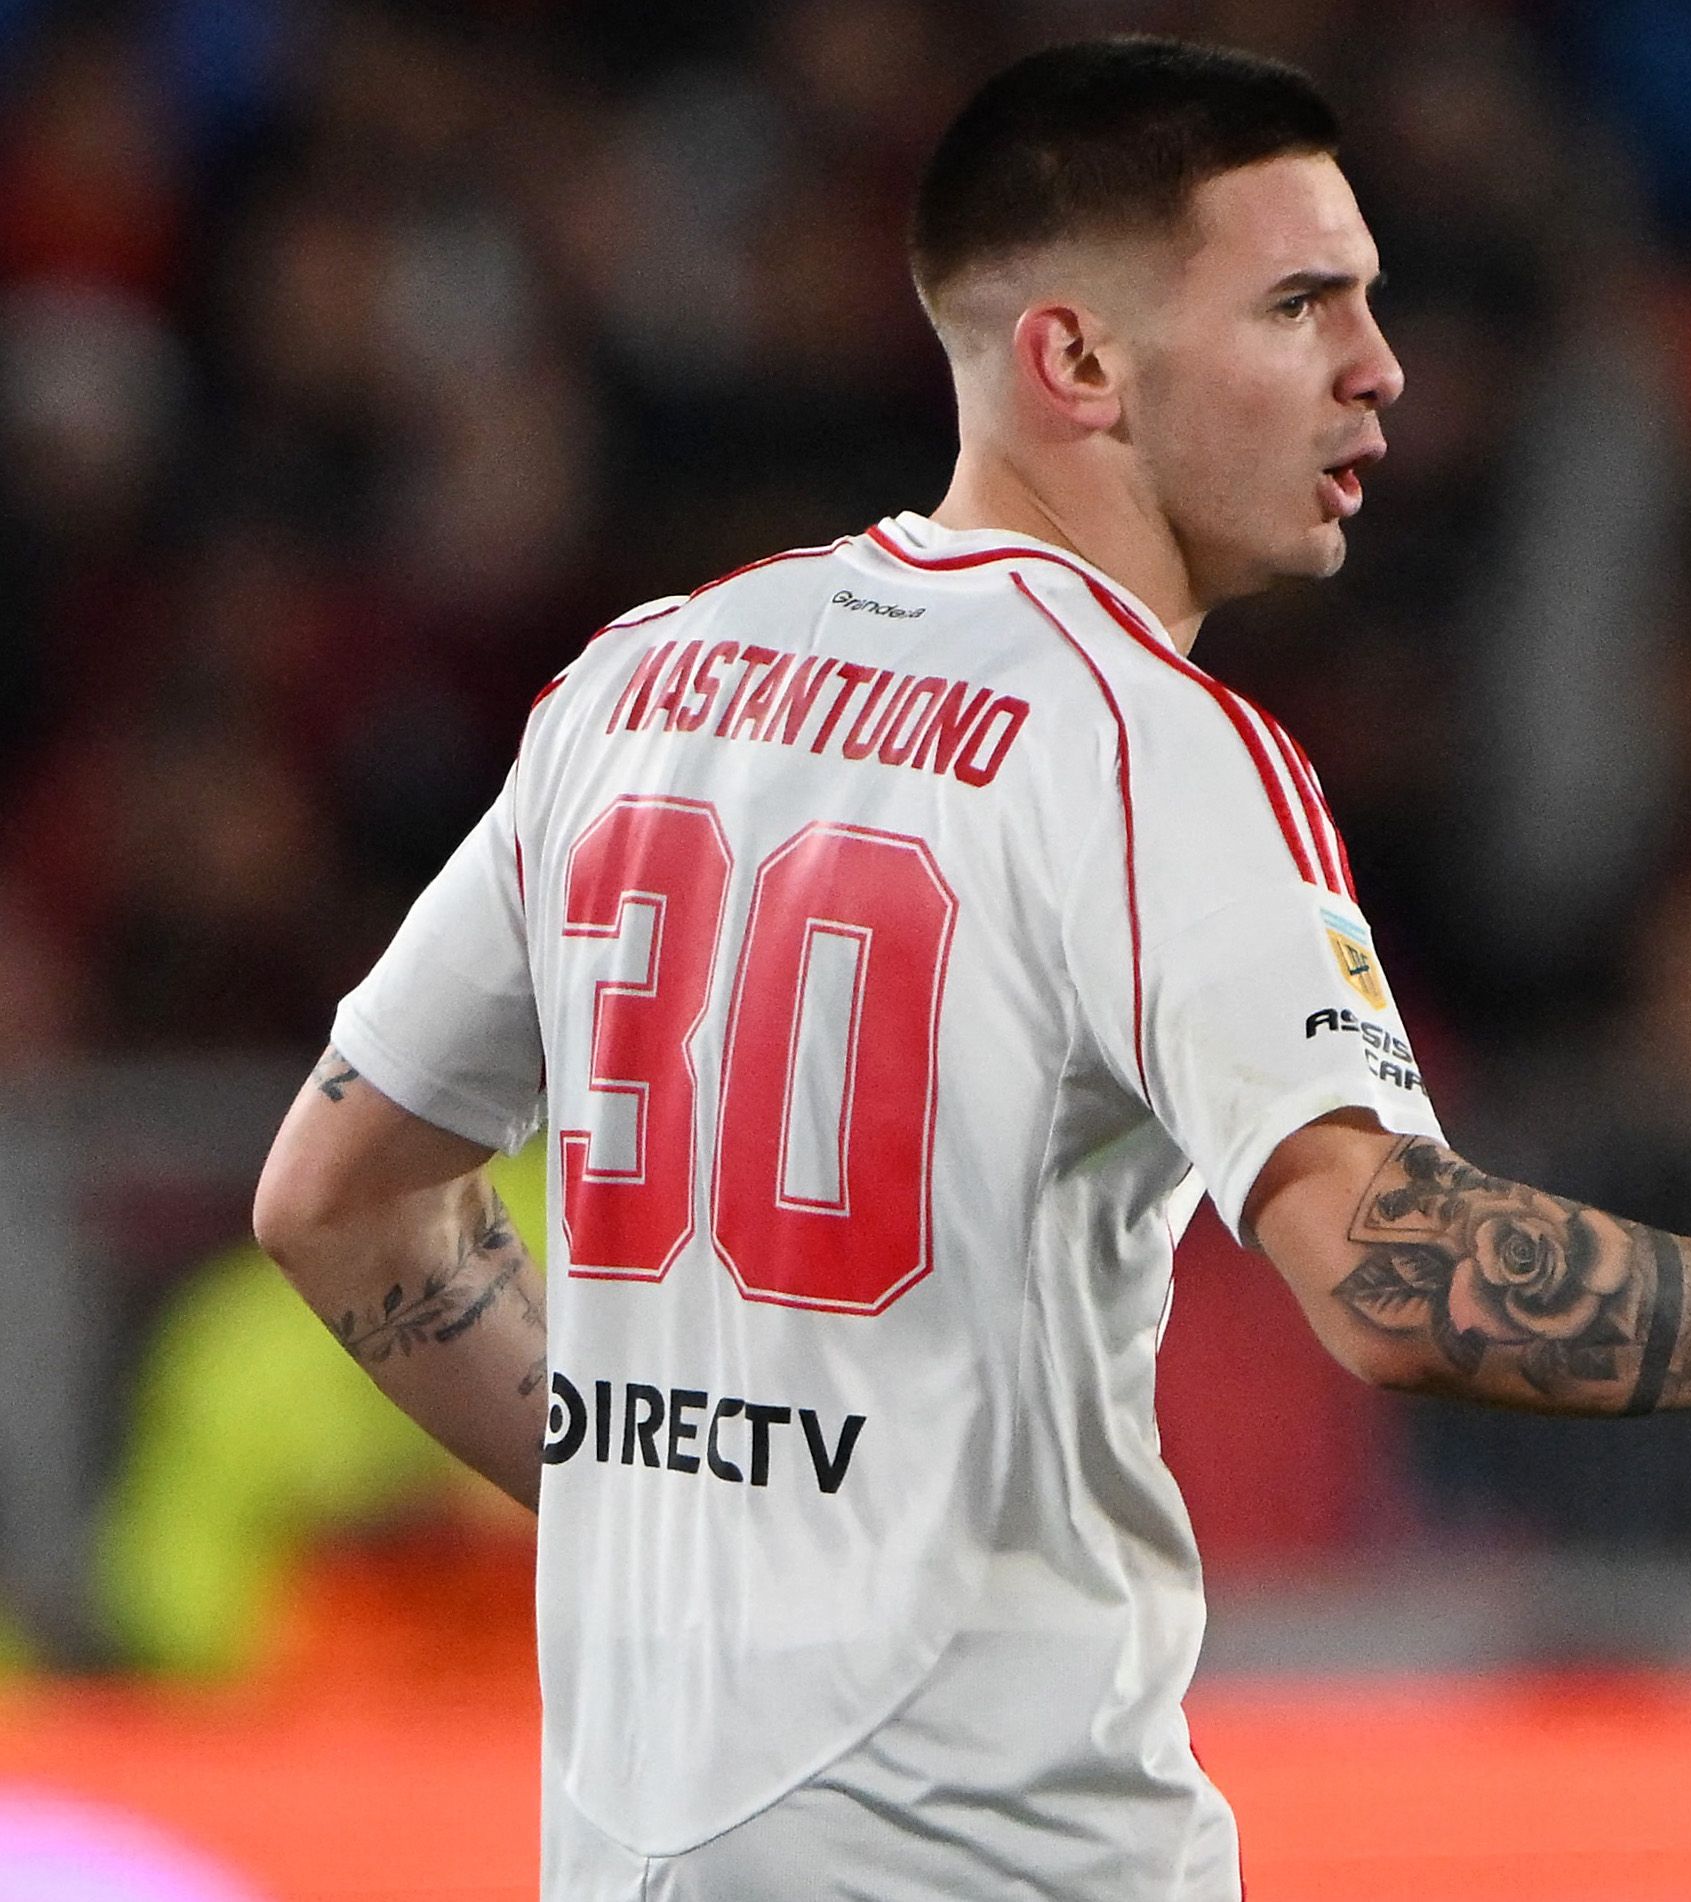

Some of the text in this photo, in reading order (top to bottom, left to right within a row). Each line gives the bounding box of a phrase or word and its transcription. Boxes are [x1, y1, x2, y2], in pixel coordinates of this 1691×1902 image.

[605, 639, 1030, 788] MASTANTUONO
[559, 793, 960, 1316] 30
[1305, 1007, 1414, 1065] ASSIS
[1364, 1048, 1430, 1097] CAR
[541, 1370, 867, 1495] DIRECTV
